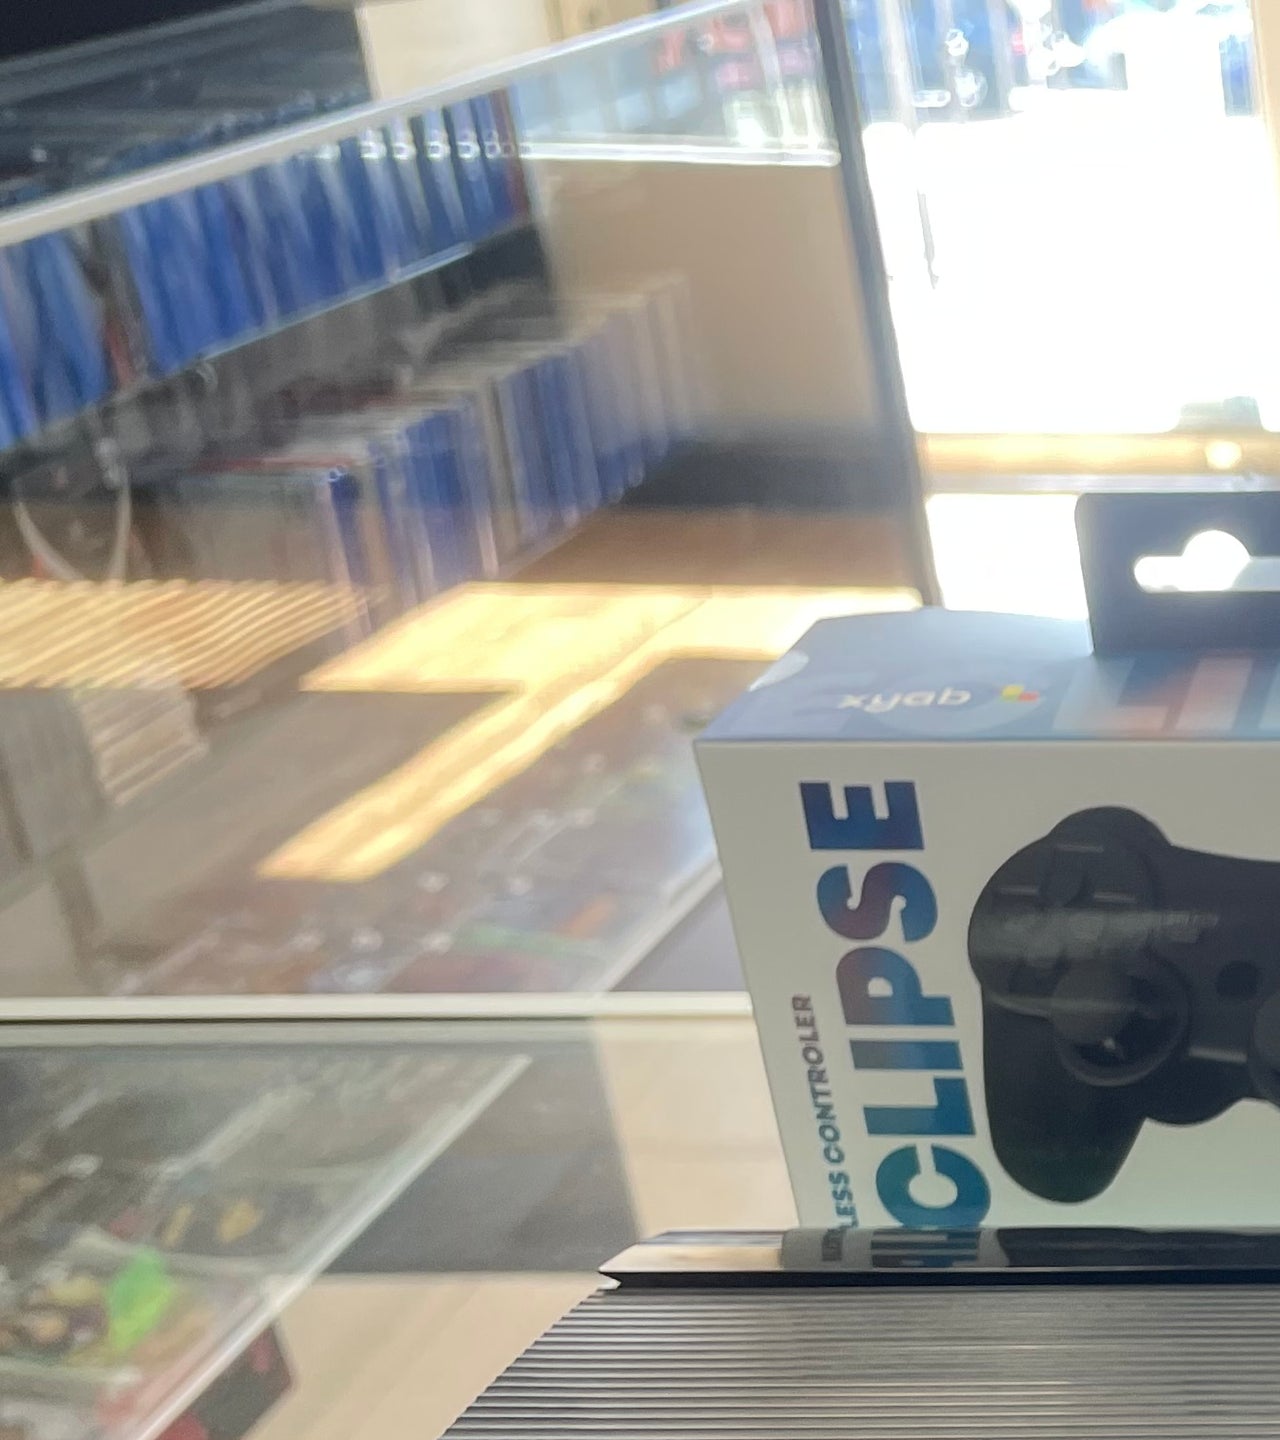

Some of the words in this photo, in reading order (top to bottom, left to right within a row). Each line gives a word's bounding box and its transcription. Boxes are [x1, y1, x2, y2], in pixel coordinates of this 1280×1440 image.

[837, 684, 971, 715] xyab
[799, 779, 992, 1229] CLIPSE
[790, 993, 847, 1165] CONTROLER
[828, 1171, 861, 1230] LESS
